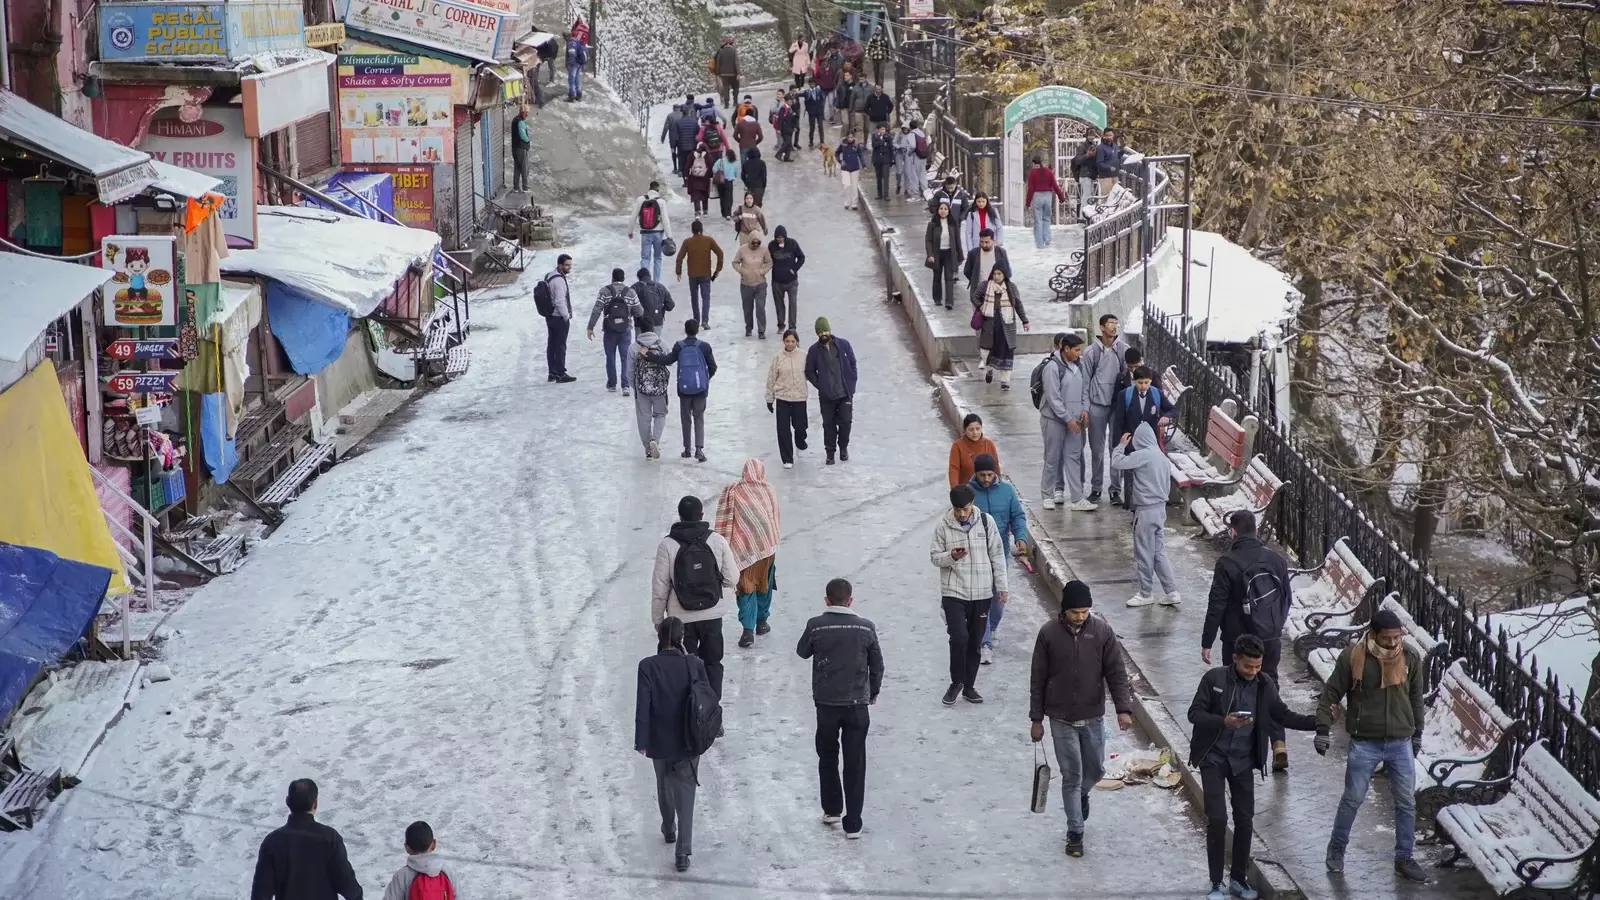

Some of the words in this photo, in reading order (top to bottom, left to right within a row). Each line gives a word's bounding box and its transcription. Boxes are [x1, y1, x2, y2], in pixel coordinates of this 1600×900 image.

[152, 12, 221, 25] REGAL
[446, 7, 496, 31] CORNER
[148, 27, 224, 41] PUBLIC
[145, 41, 227, 56] SCHOOL
[343, 56, 389, 65] Himachal
[391, 55, 416, 65] Juice
[364, 66, 394, 75] Corner
[345, 77, 376, 86] Shakes
[381, 77, 389, 85] &
[391, 76, 415, 87] Softy
[417, 76, 450, 85] Corner
[173, 151, 236, 169] FRUITS
[392, 173, 429, 189] TIBET
[134, 343, 164, 353] BURGER
[135, 377, 165, 387] PIZZA
